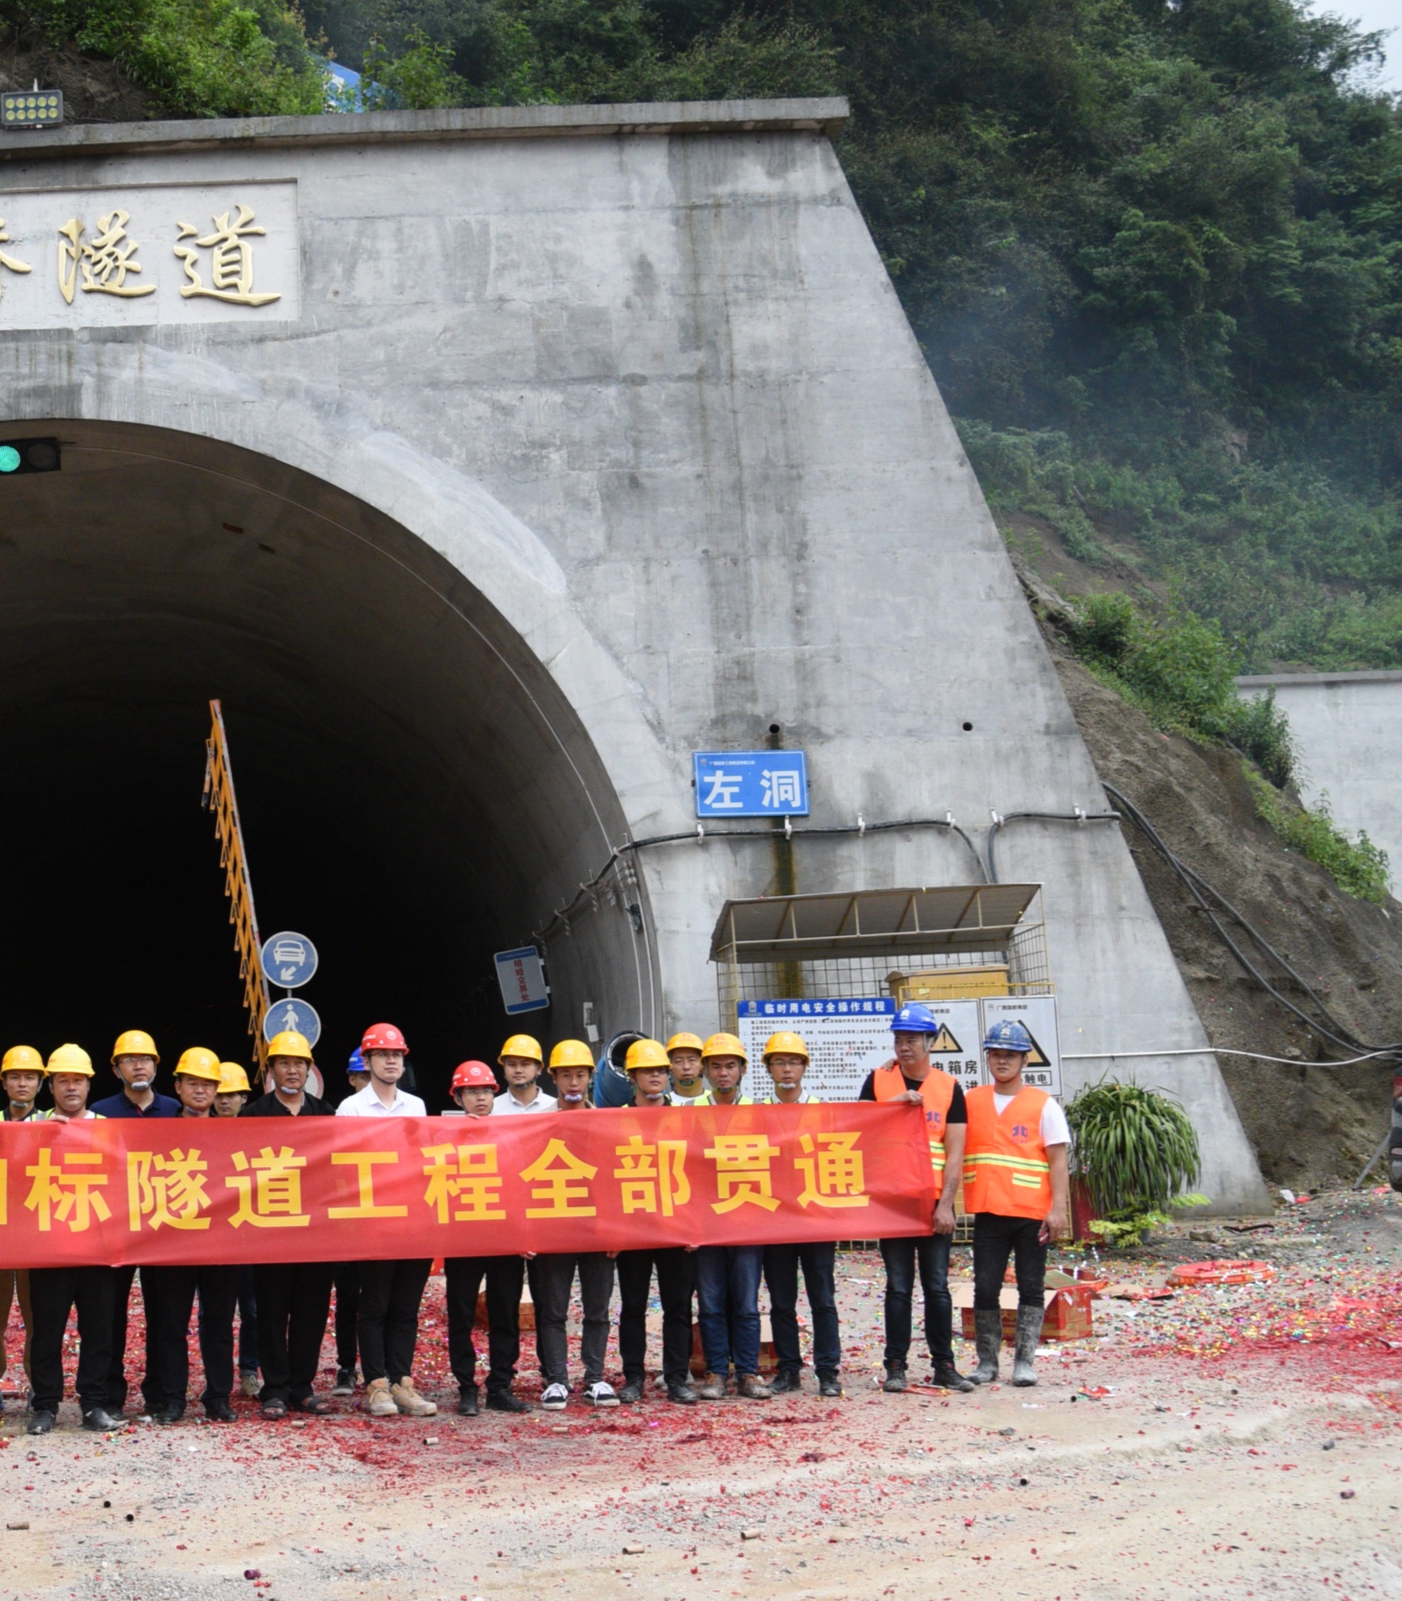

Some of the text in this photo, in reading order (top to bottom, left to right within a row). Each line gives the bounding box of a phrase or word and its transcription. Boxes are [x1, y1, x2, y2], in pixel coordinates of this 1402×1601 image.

[703, 768, 802, 809] 左洞
[764, 1000, 886, 1014] 临时用电安全操作规程
[931, 1059, 978, 1075] 电箱房
[1022, 1073, 1048, 1084] 触电
